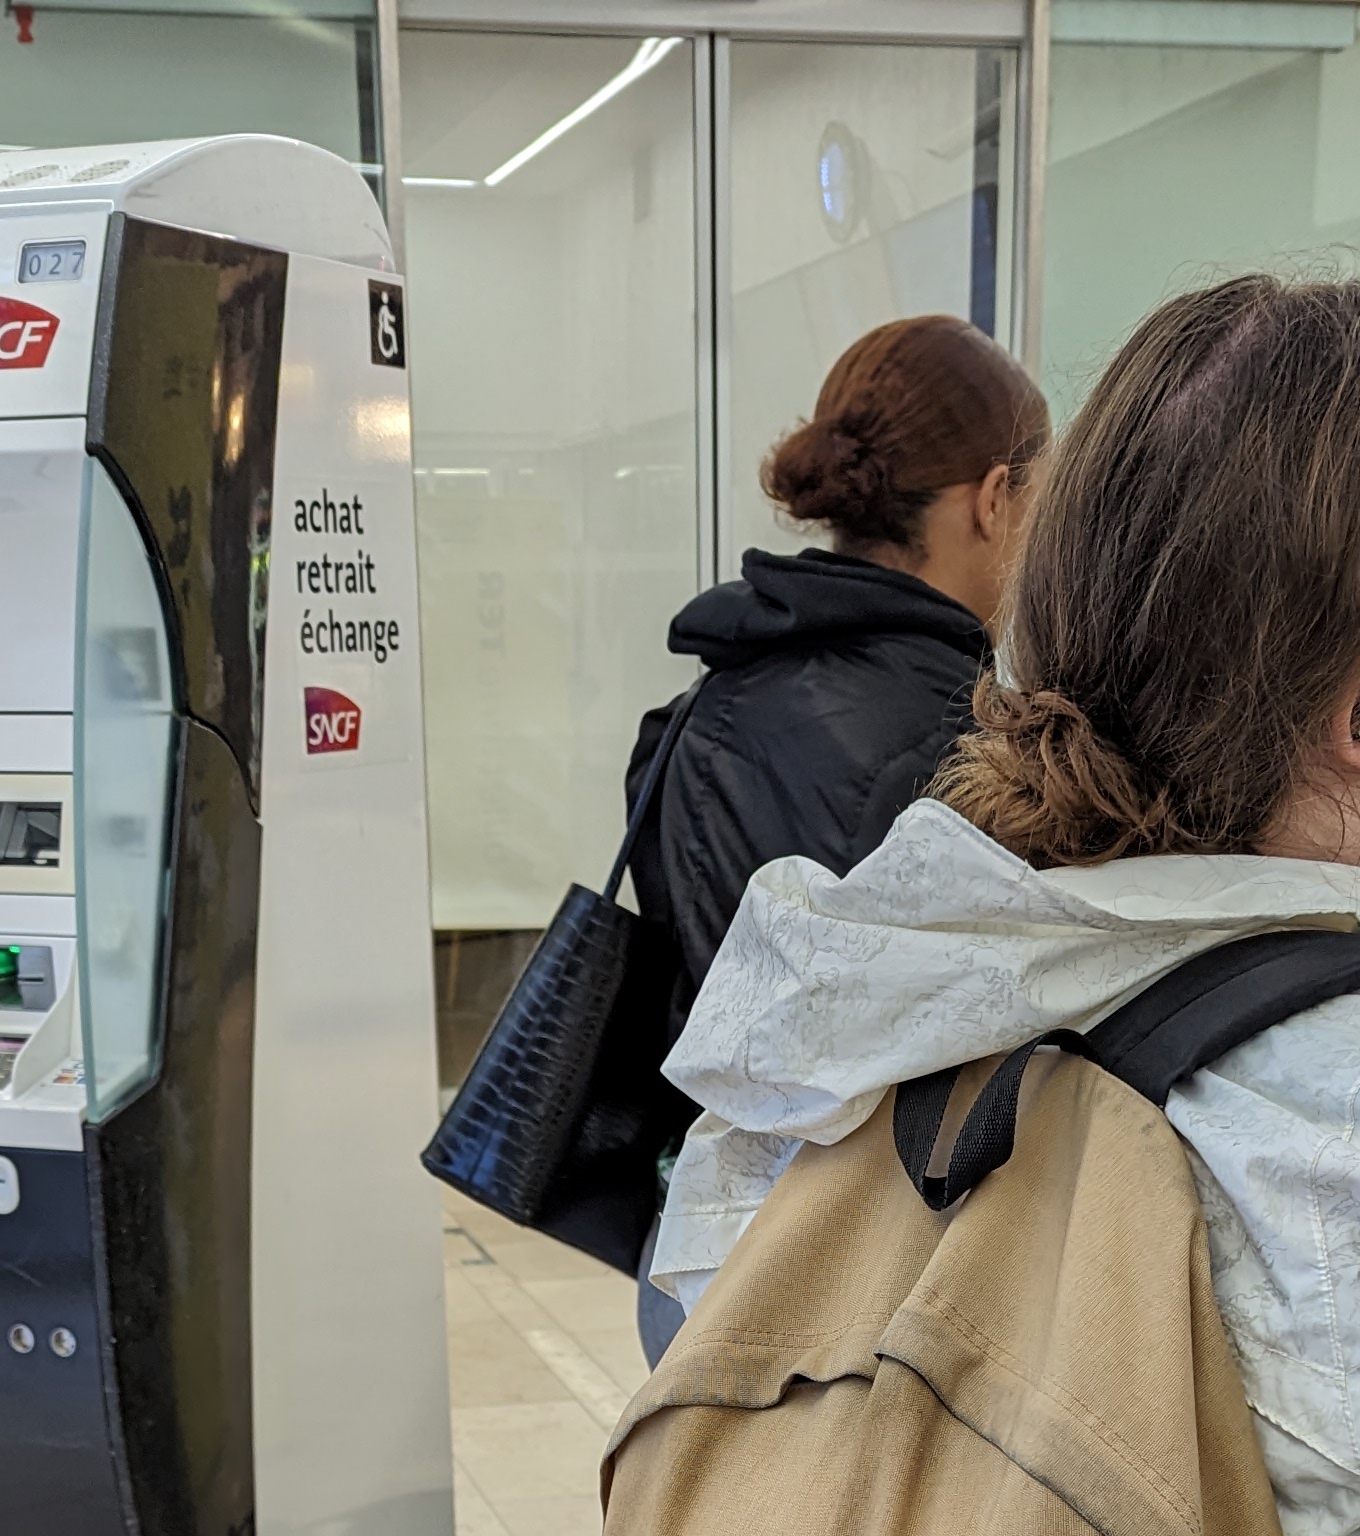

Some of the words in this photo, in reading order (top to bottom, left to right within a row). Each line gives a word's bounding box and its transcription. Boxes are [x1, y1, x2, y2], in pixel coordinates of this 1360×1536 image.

[29, 252, 84, 276] 027
[293, 488, 364, 534] achat
[297, 550, 377, 594] retrait
[300, 609, 400, 663] échange
[308, 709, 359, 746] SNCF
